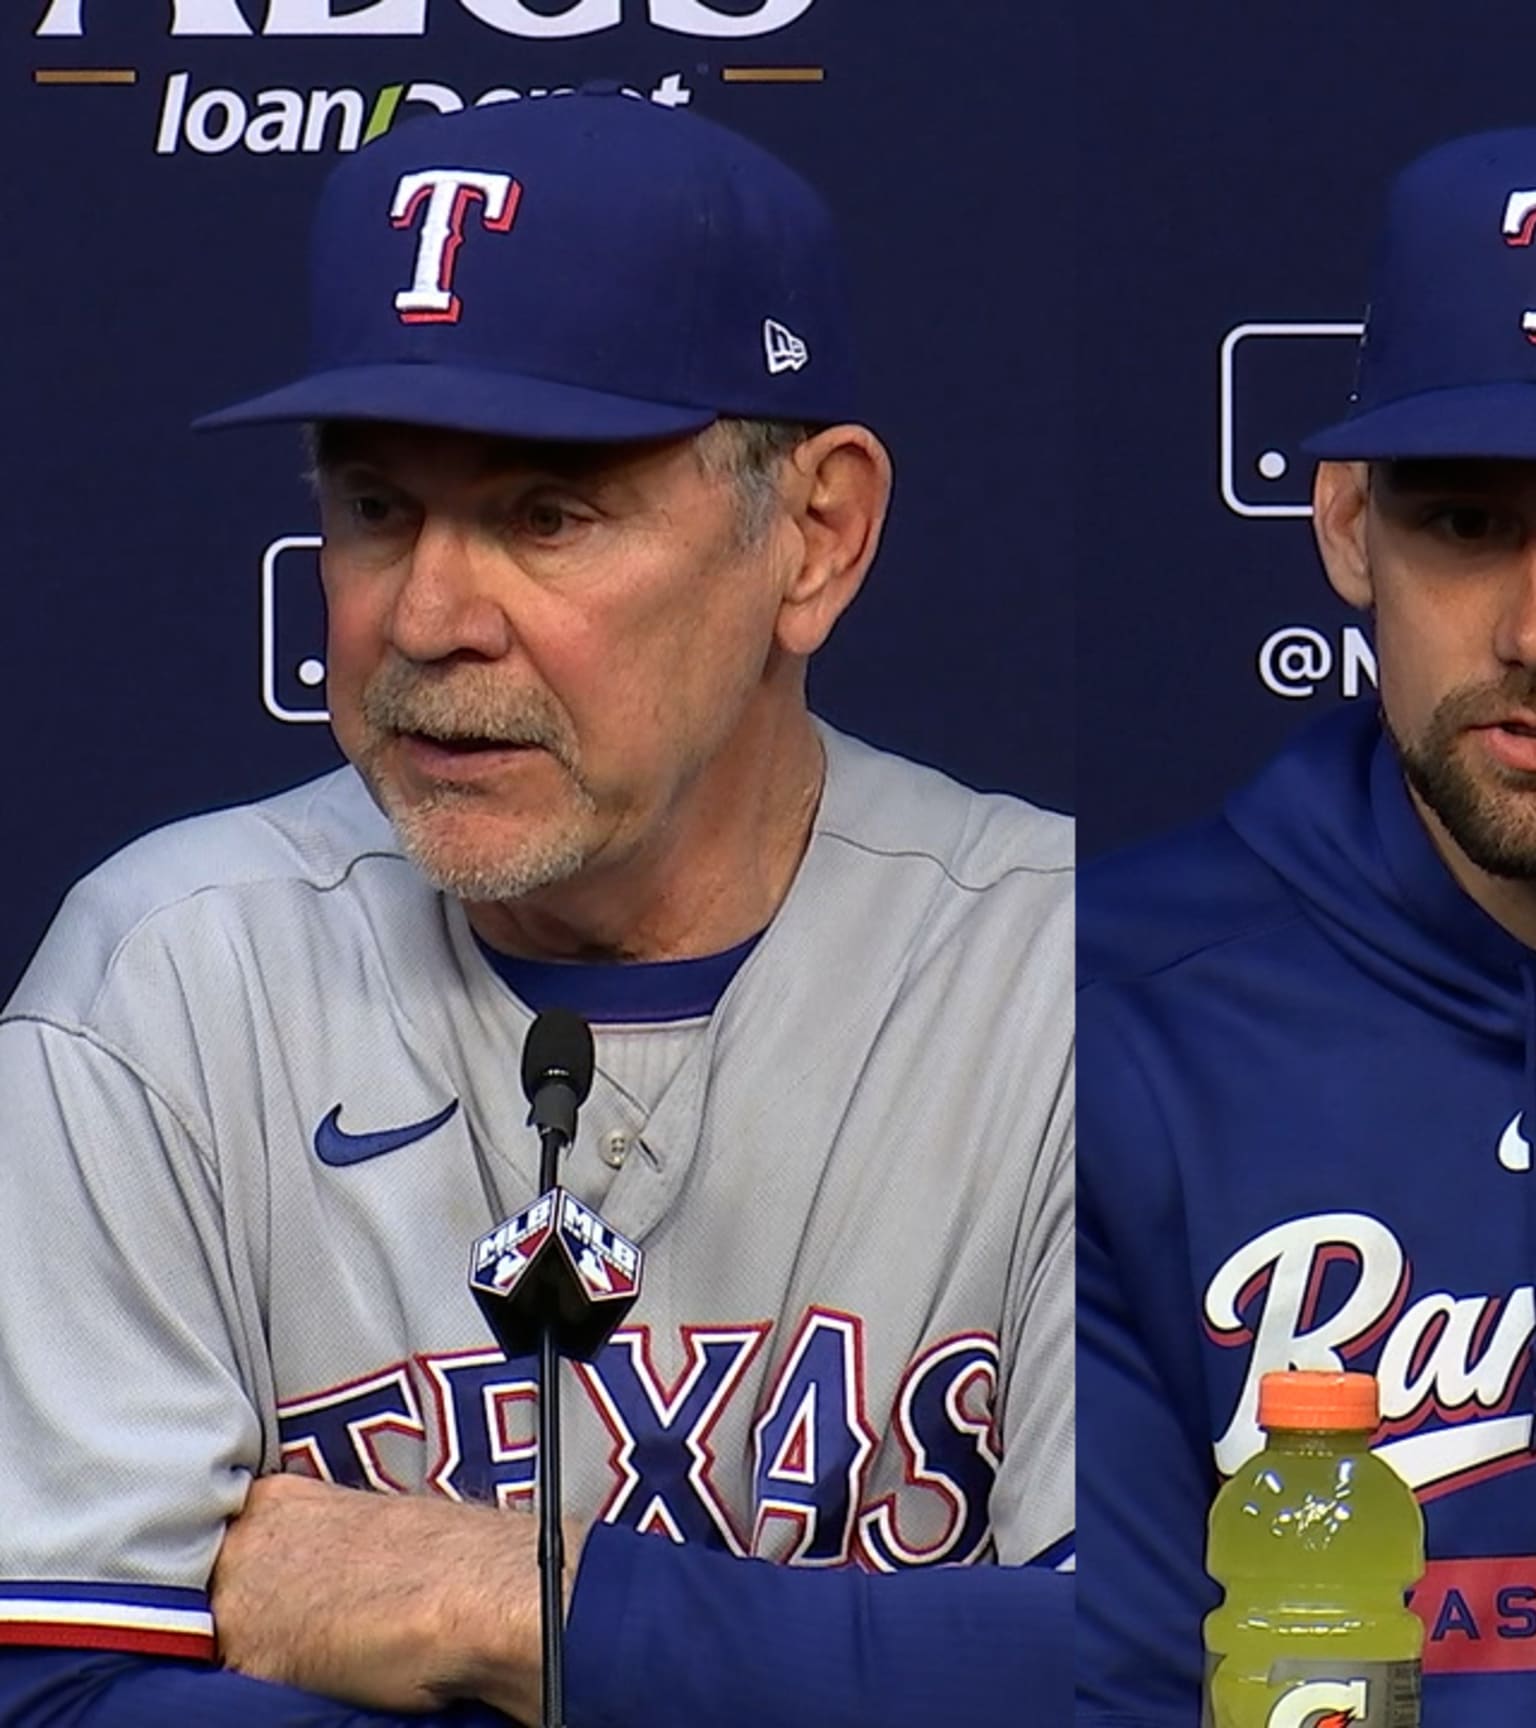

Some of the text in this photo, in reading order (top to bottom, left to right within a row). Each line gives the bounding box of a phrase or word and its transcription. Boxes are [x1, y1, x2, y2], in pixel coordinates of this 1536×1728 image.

[390, 168, 522, 325] T
[479, 1199, 551, 1264] MLB
[563, 1200, 637, 1270] MLB
[278, 1305, 1003, 1574] TEXAS
